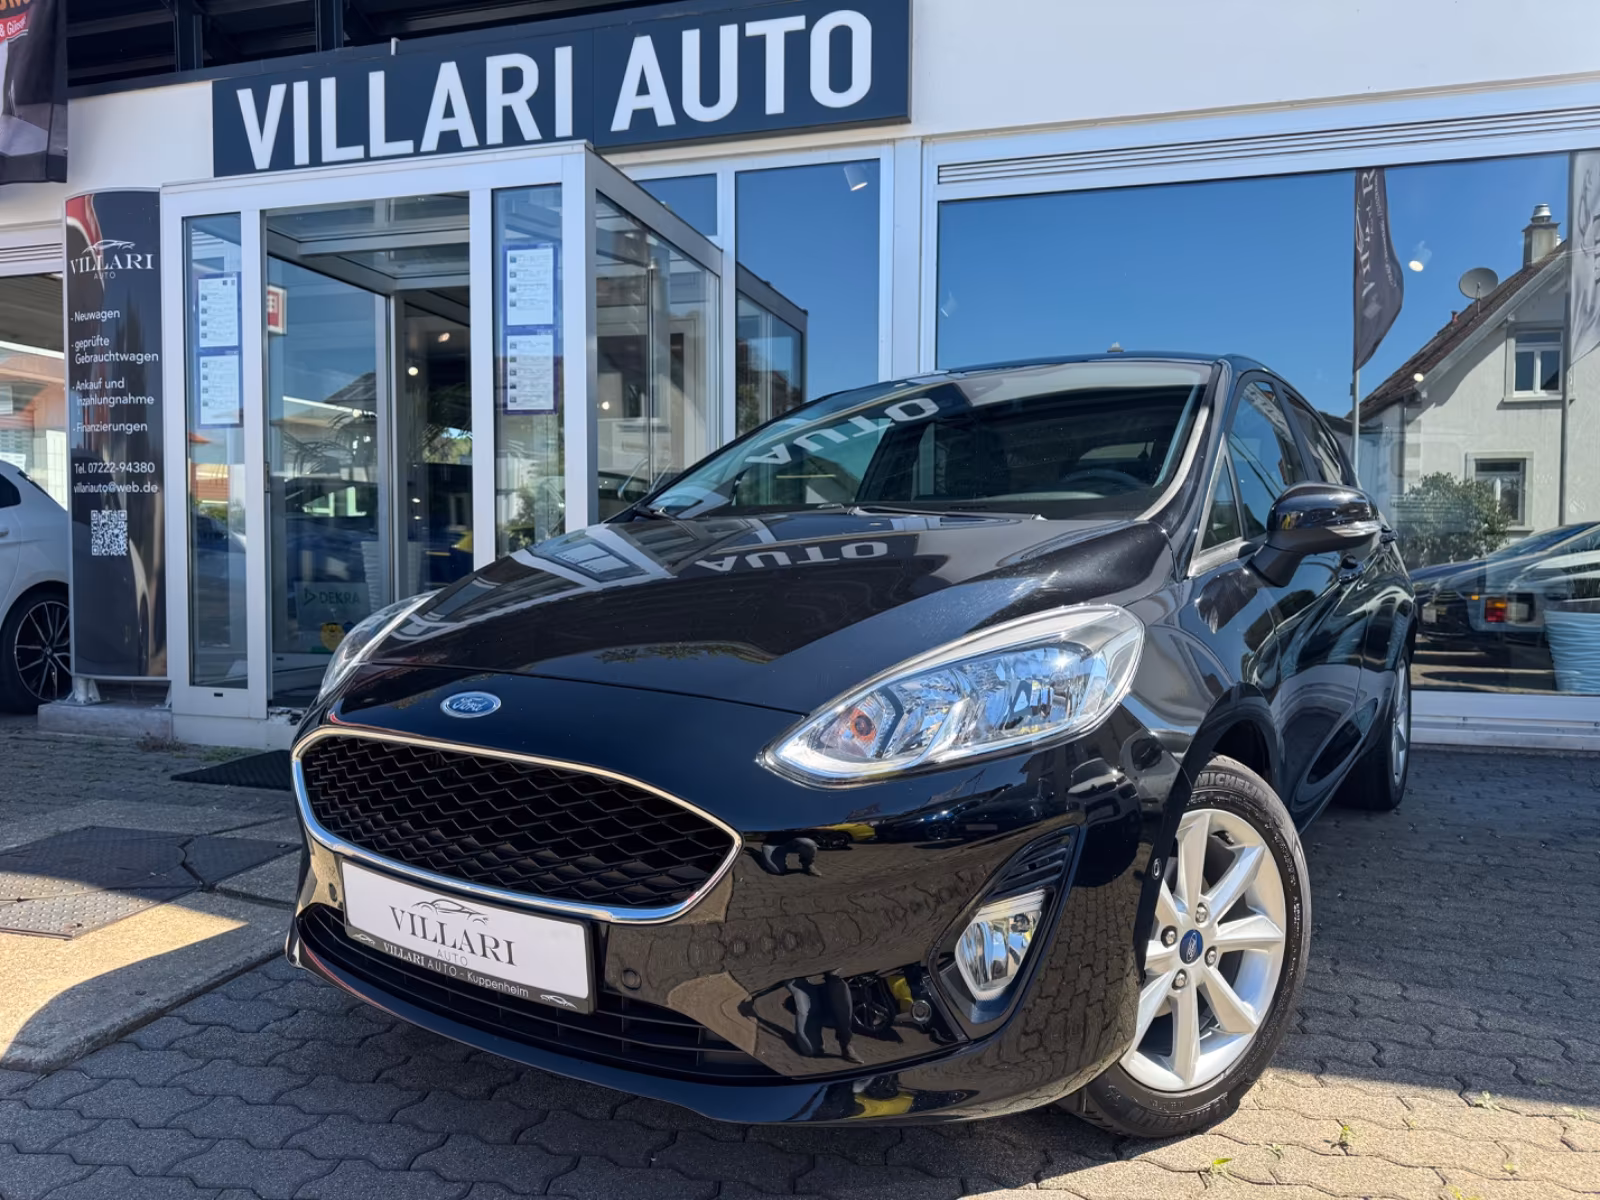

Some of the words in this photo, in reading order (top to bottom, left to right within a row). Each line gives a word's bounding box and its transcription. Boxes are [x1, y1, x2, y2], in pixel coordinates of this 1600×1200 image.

[236, 46, 573, 170] VILLARI
[610, 10, 872, 131] AUTO
[70, 253, 154, 274] VILLARI
[94, 271, 116, 279] AUTO
[75, 309, 121, 322] Neuwagen
[75, 334, 110, 352] geprüfte
[75, 350, 159, 365] Gebrauchtwagen
[75, 377, 102, 391] Ankauf
[104, 376, 125, 389] und
[76, 421, 148, 434] Finanzierungen
[88, 461, 156, 474] 07222-94380
[319, 591, 361, 605] DEKRA
[452, 697, 488, 712] Ford
[389, 905, 518, 966] VILLARI
[436, 948, 468, 967] AUTO
[383, 942, 426, 967] VILLARI
[427, 960, 457, 977] AUTO
[467, 971, 529, 998] Kuppenheim
